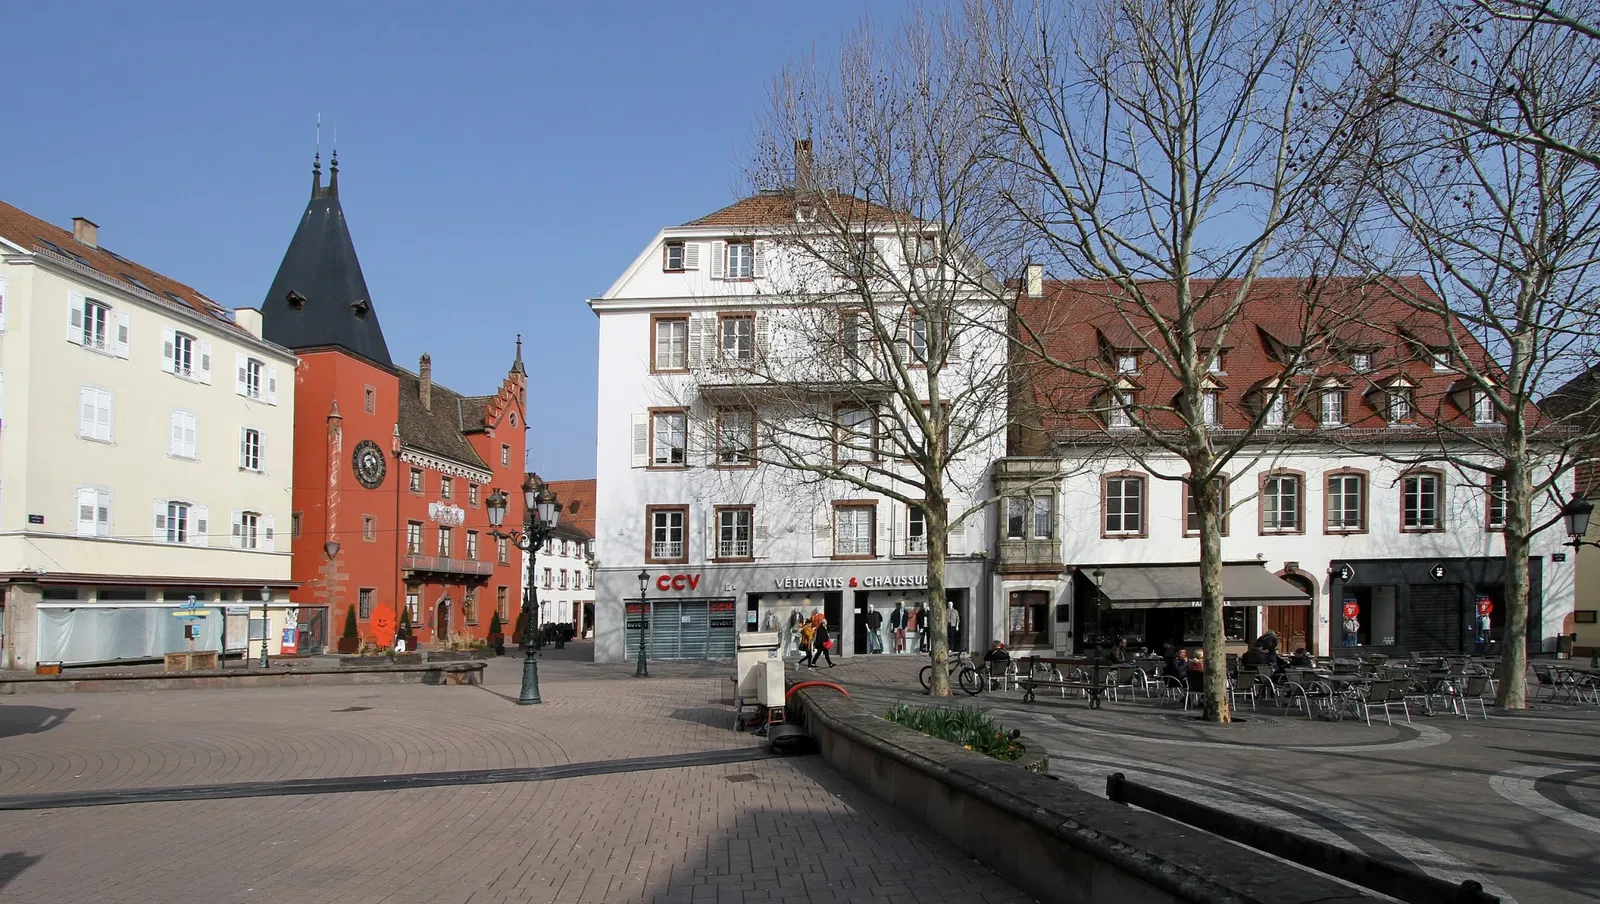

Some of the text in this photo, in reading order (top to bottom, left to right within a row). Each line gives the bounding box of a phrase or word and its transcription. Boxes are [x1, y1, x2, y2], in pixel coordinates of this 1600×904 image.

[656, 574, 701, 591] CCV
[775, 576, 844, 588] VÊTEMENTS
[864, 575, 929, 586] CHAUSSUR
